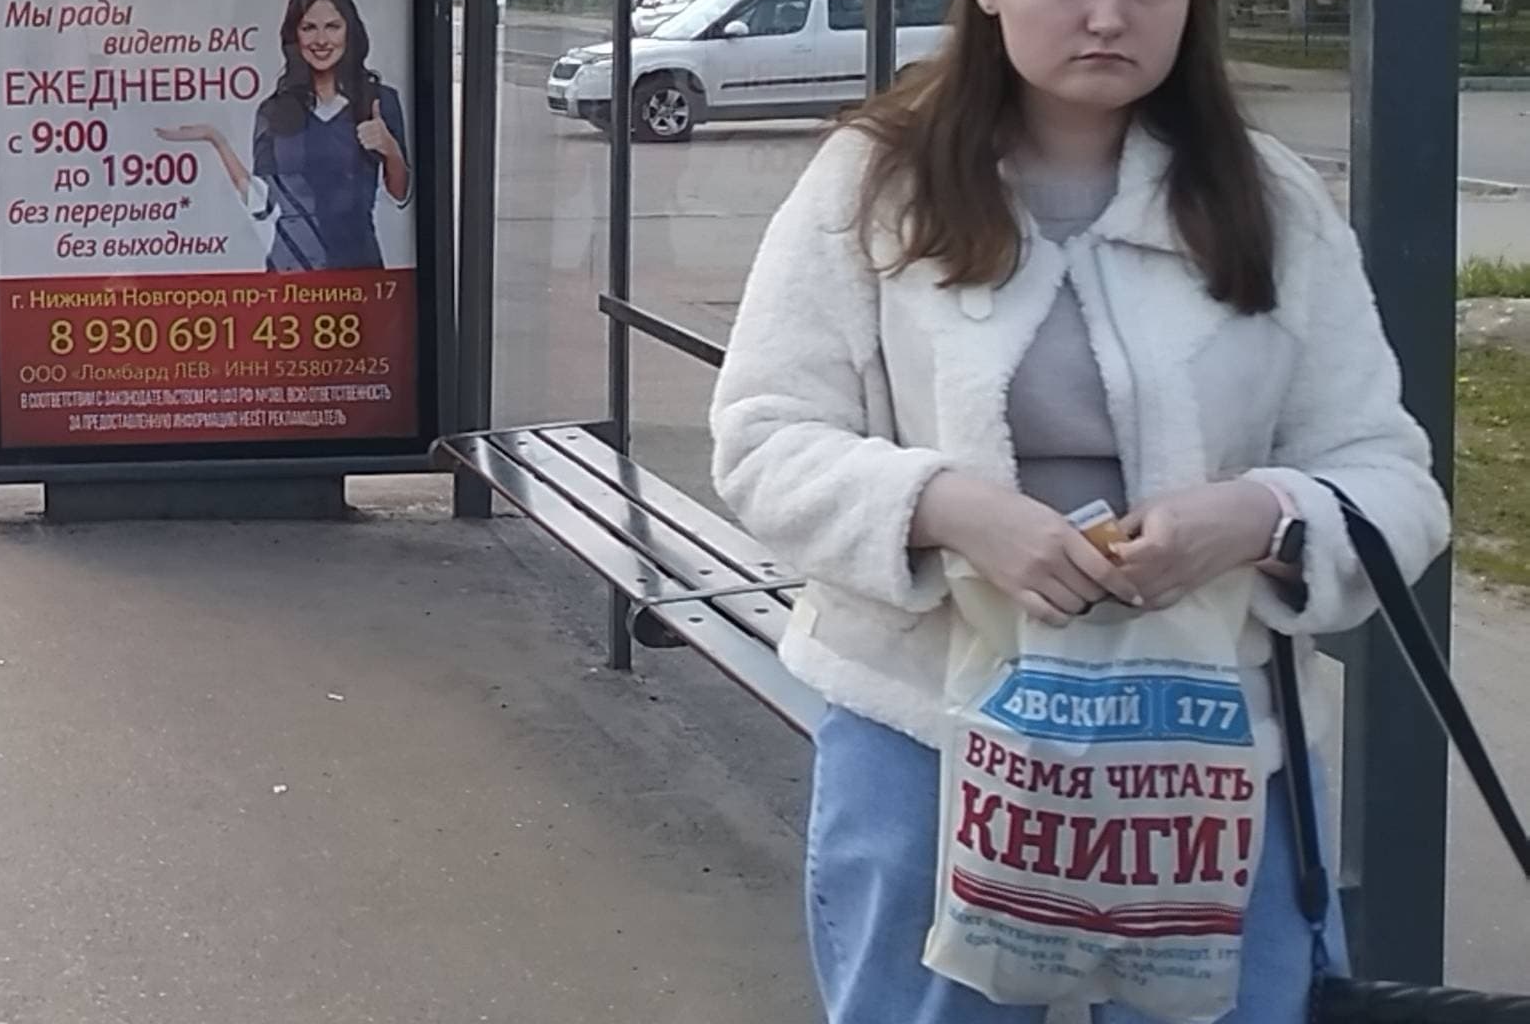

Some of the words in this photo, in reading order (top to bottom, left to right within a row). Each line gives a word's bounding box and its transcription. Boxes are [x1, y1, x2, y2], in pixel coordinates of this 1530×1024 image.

[5, 1, 52, 28] Мы
[58, 0, 132, 32] рады
[103, 31, 201, 56] видеть
[208, 27, 259, 52] ВАС
[5, 66, 260, 110] ЕЖЕДНЕВНО
[31, 120, 108, 153] 9:00
[54, 168, 90, 192] до
[101, 153, 198, 187] 19:00
[8, 200, 48, 225] без
[57, 232, 98, 258] без
[103, 231, 228, 256] выходных
[12, 295, 25, 309] г.
[30, 288, 115, 309] Нижний
[122, 288, 227, 311] Новгород
[232, 290, 278, 308] пр-т
[282, 284, 368, 304] Ленина,
[375, 281, 397, 300] 17
[50, 320, 74, 355] 8
[84, 318, 158, 353] 930
[169, 317, 236, 352] 691
[252, 315, 301, 350] 43
[313, 314, 361, 349] 88
[20, 365, 67, 384] ООО
[225, 360, 270, 378] ИНН
[275, 357, 389, 377] 5258072425
[1176, 696, 1239, 730] 177
[966, 731, 1094, 799] ВРЕМЯ
[1107, 763, 1254, 801] ЧИТАТЬ
[956, 780, 1254, 888] КНИГИ!
